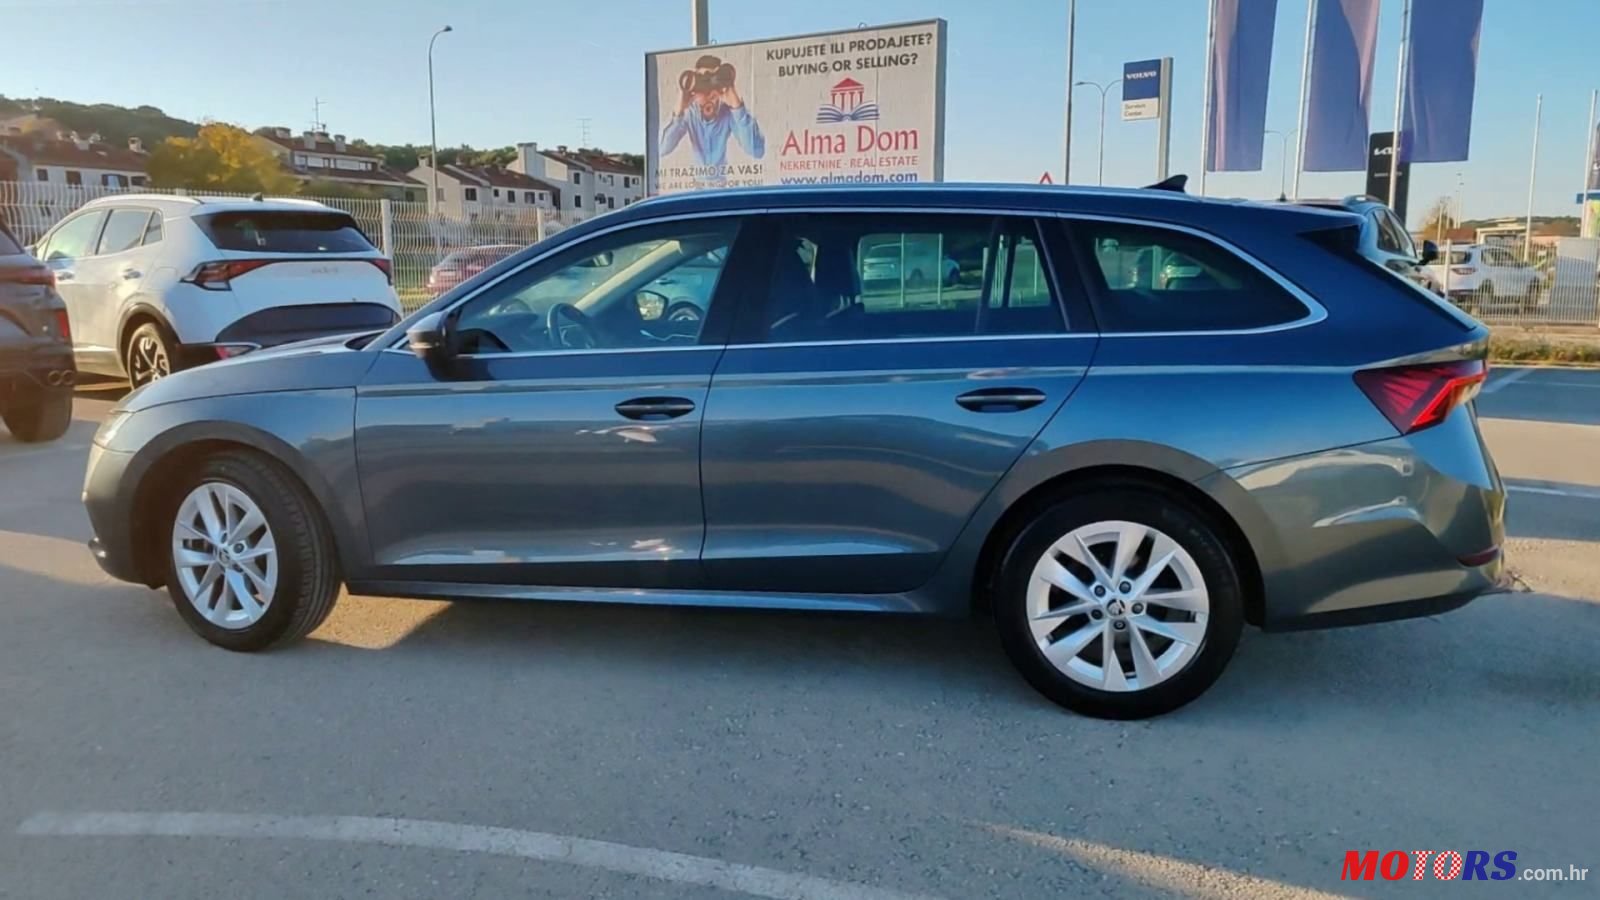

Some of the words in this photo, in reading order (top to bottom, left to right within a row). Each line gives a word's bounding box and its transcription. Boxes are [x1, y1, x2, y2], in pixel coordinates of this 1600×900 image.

[766, 43, 826, 61] KUPUJETE
[830, 41, 845, 54] ILI
[849, 32, 933, 52] PRODAJETE?
[778, 61, 828, 77] BUYING
[832, 59, 852, 72] OR
[856, 52, 918, 70] SELLING?
[1126, 71, 1157, 79] VOLVO
[781, 129, 846, 156] Alma
[857, 125, 918, 152] Dom
[738, 163, 763, 175] VAS!
[780, 159, 842, 170] NEKRETNINE
[850, 157, 876, 168] REAL
[879, 155, 918, 166] ESTATE
[780, 170, 918, 185] www.almadom.com
